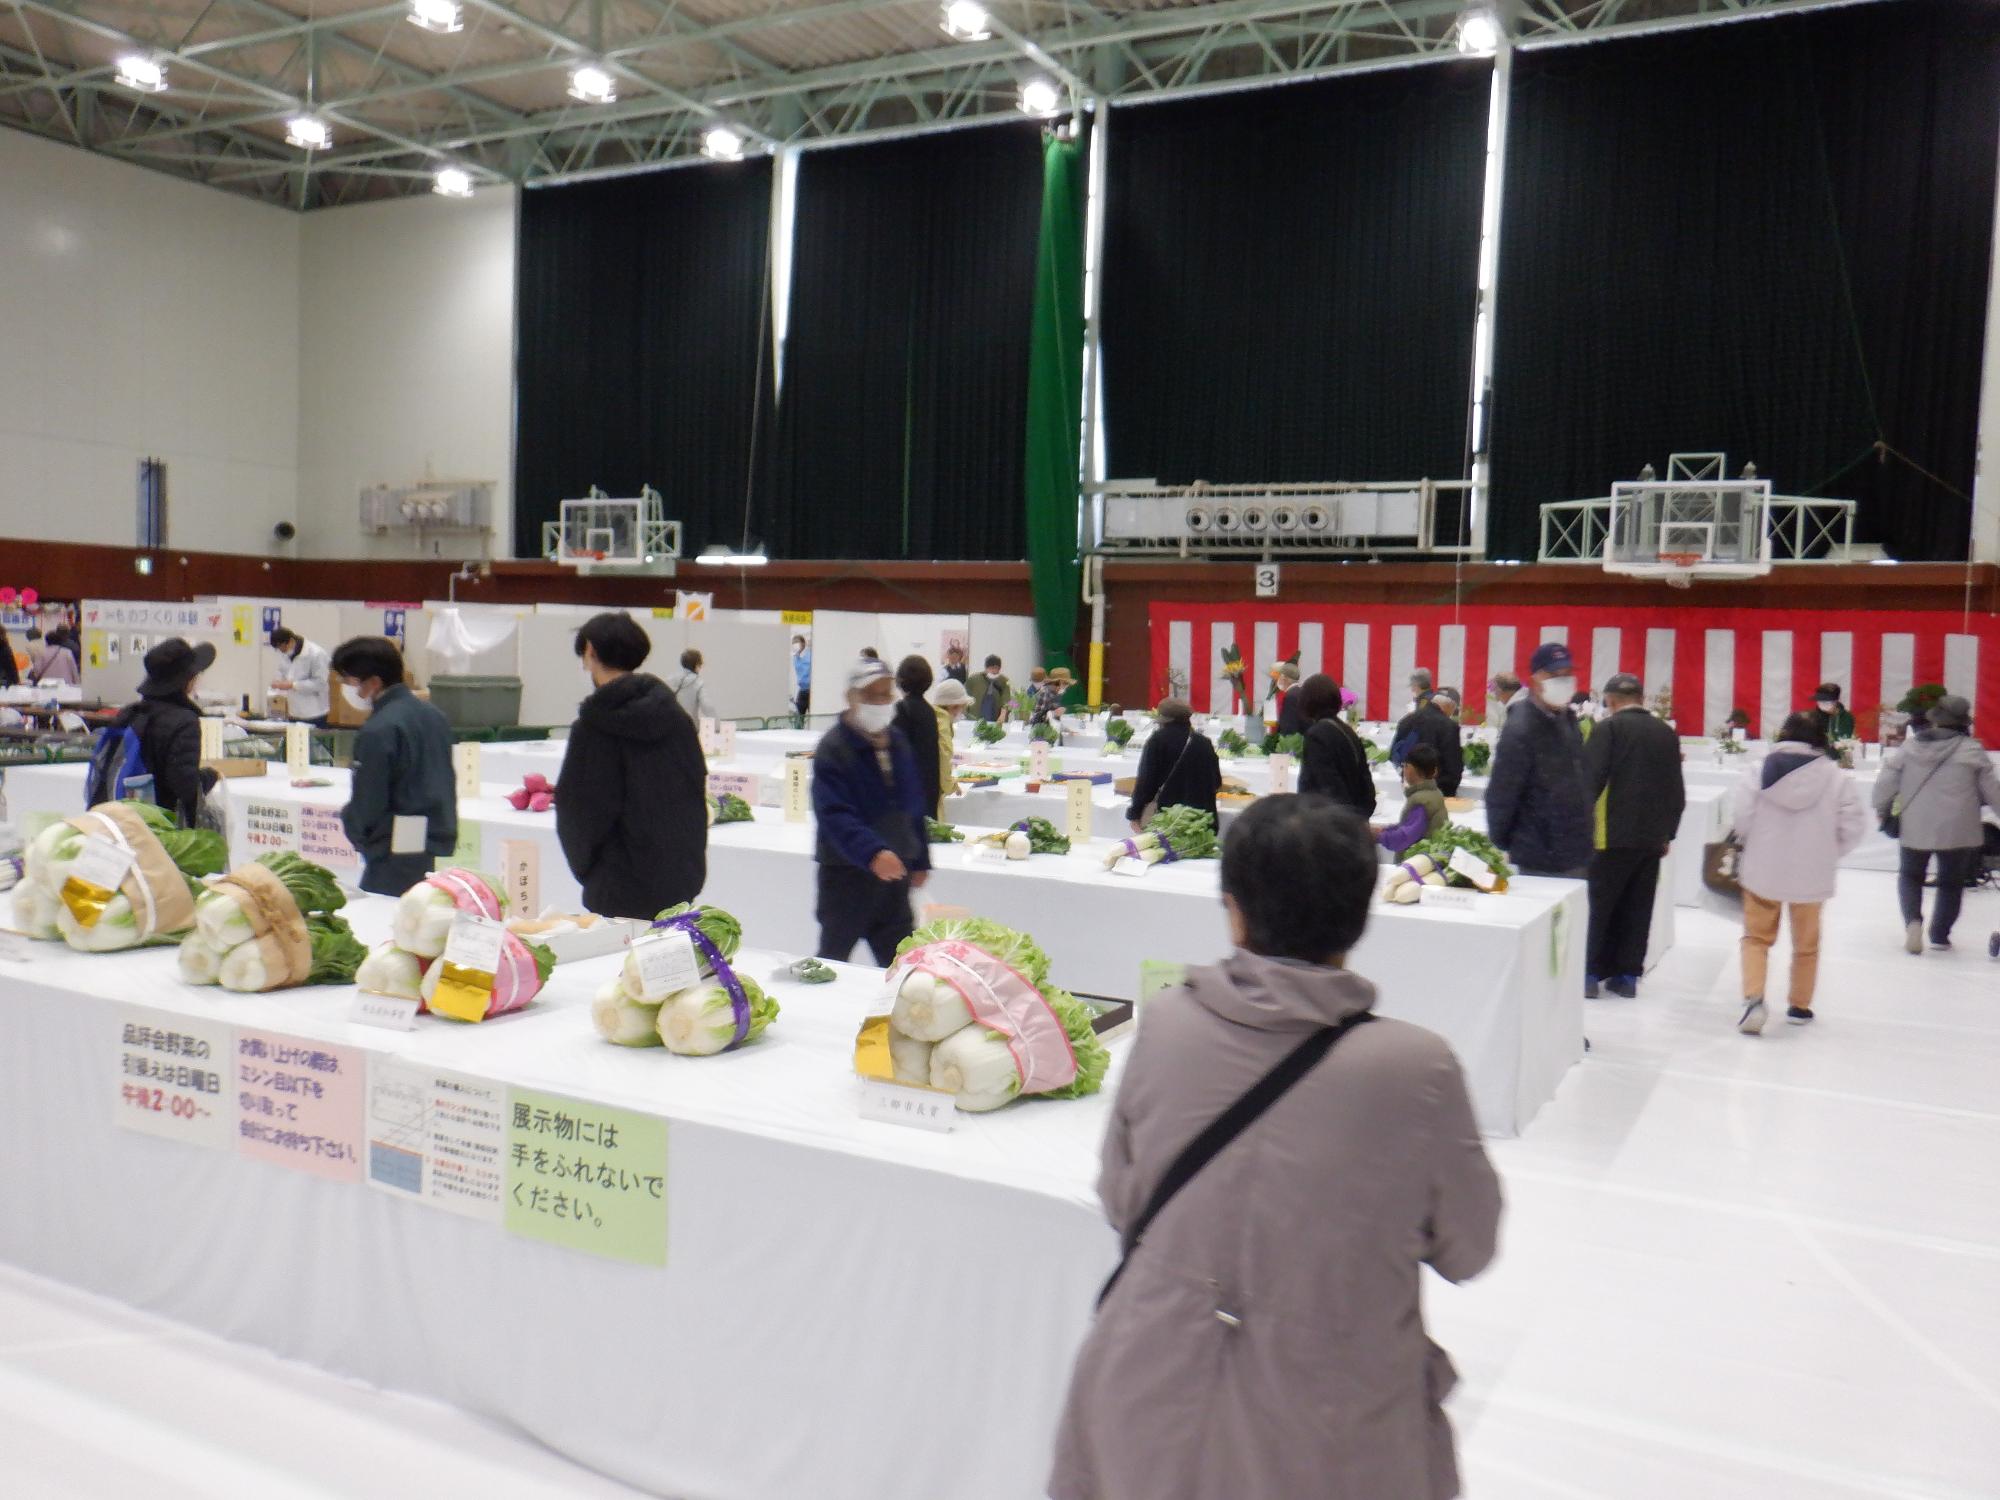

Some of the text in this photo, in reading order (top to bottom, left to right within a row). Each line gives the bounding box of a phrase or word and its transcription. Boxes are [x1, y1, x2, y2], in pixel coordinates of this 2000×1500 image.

[1259, 570, 1275, 588] 3
[511, 1102, 620, 1149] 展示物には
[511, 1142, 664, 1199] 手をふれないで
[512, 1182, 603, 1228] ください。
